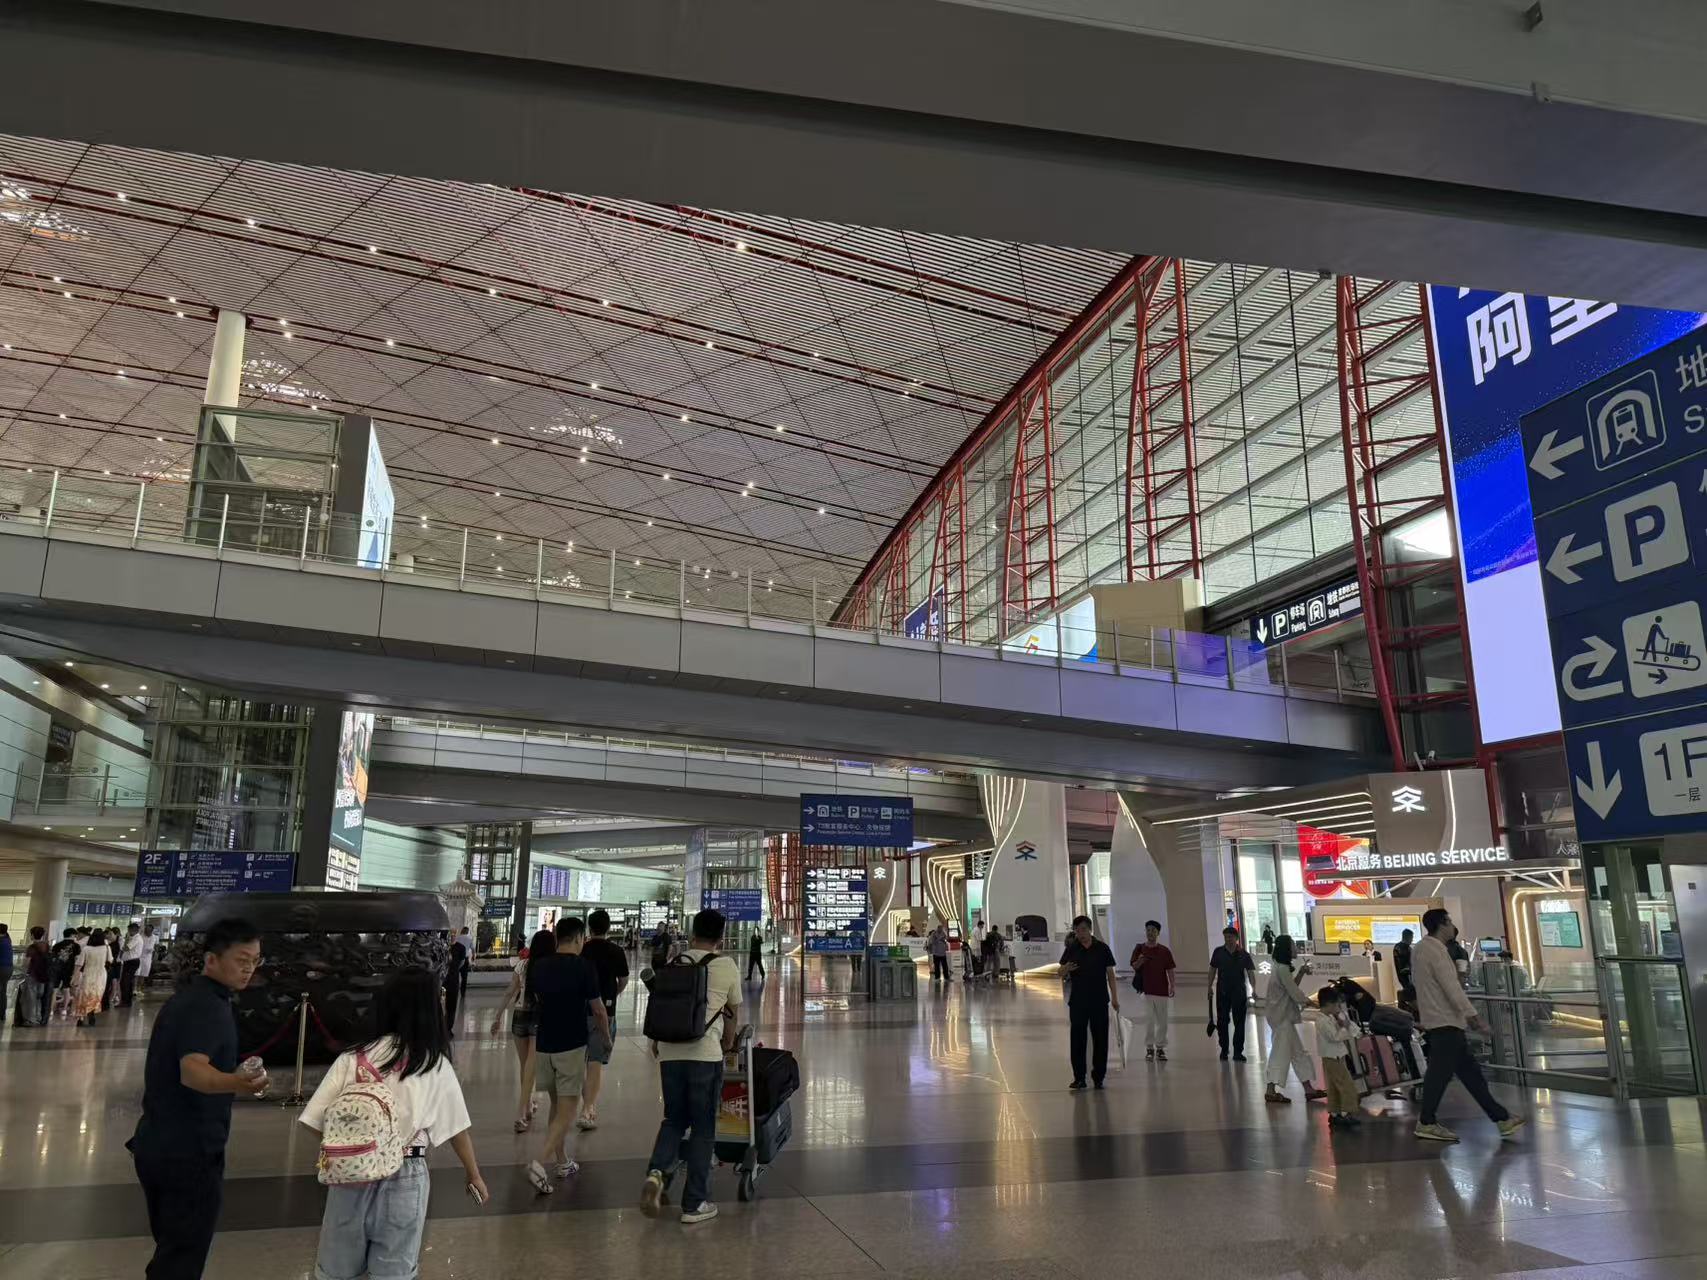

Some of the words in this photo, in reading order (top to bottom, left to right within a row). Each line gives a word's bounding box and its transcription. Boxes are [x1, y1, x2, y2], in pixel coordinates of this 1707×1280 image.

[1684, 404, 1707, 434] S
[1624, 504, 1666, 568] P
[1275, 613, 1286, 636] P
[1654, 735, 1707, 781] 1F
[1674, 786, 1701, 802] 一层
[850, 808, 858, 816] P
[143, 853, 162, 864] 2F
[1337, 854, 1382, 872] 北京服务
[1383, 852, 1436, 869] BEIJING
[1441, 847, 1506, 865] SERVICE
